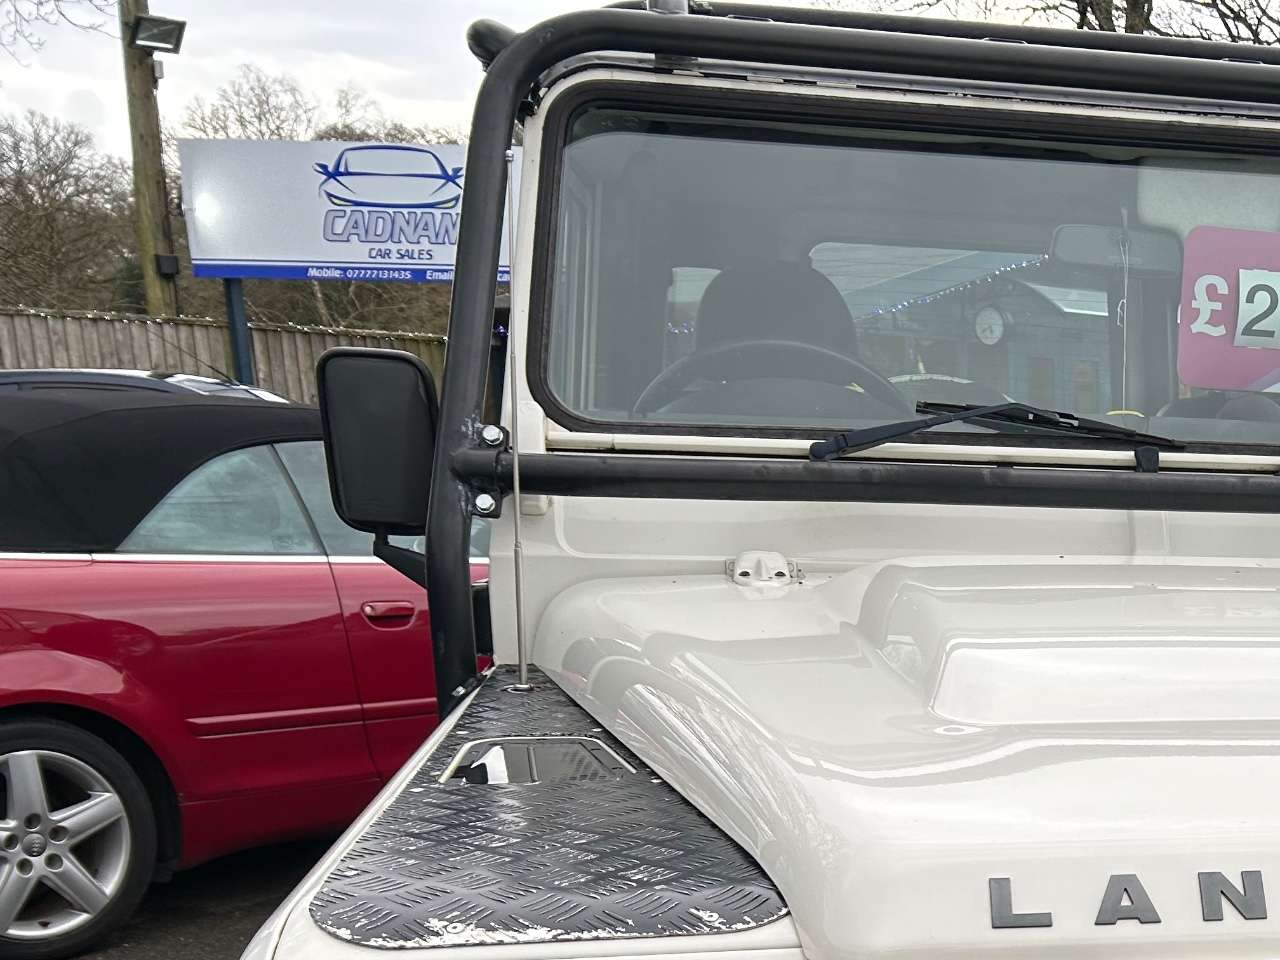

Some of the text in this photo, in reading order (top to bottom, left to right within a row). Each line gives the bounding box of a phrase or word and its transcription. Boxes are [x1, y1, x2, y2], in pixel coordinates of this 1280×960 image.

[368, 248, 433, 261] CAR SALES
[307, 267, 344, 278] Mobile:
